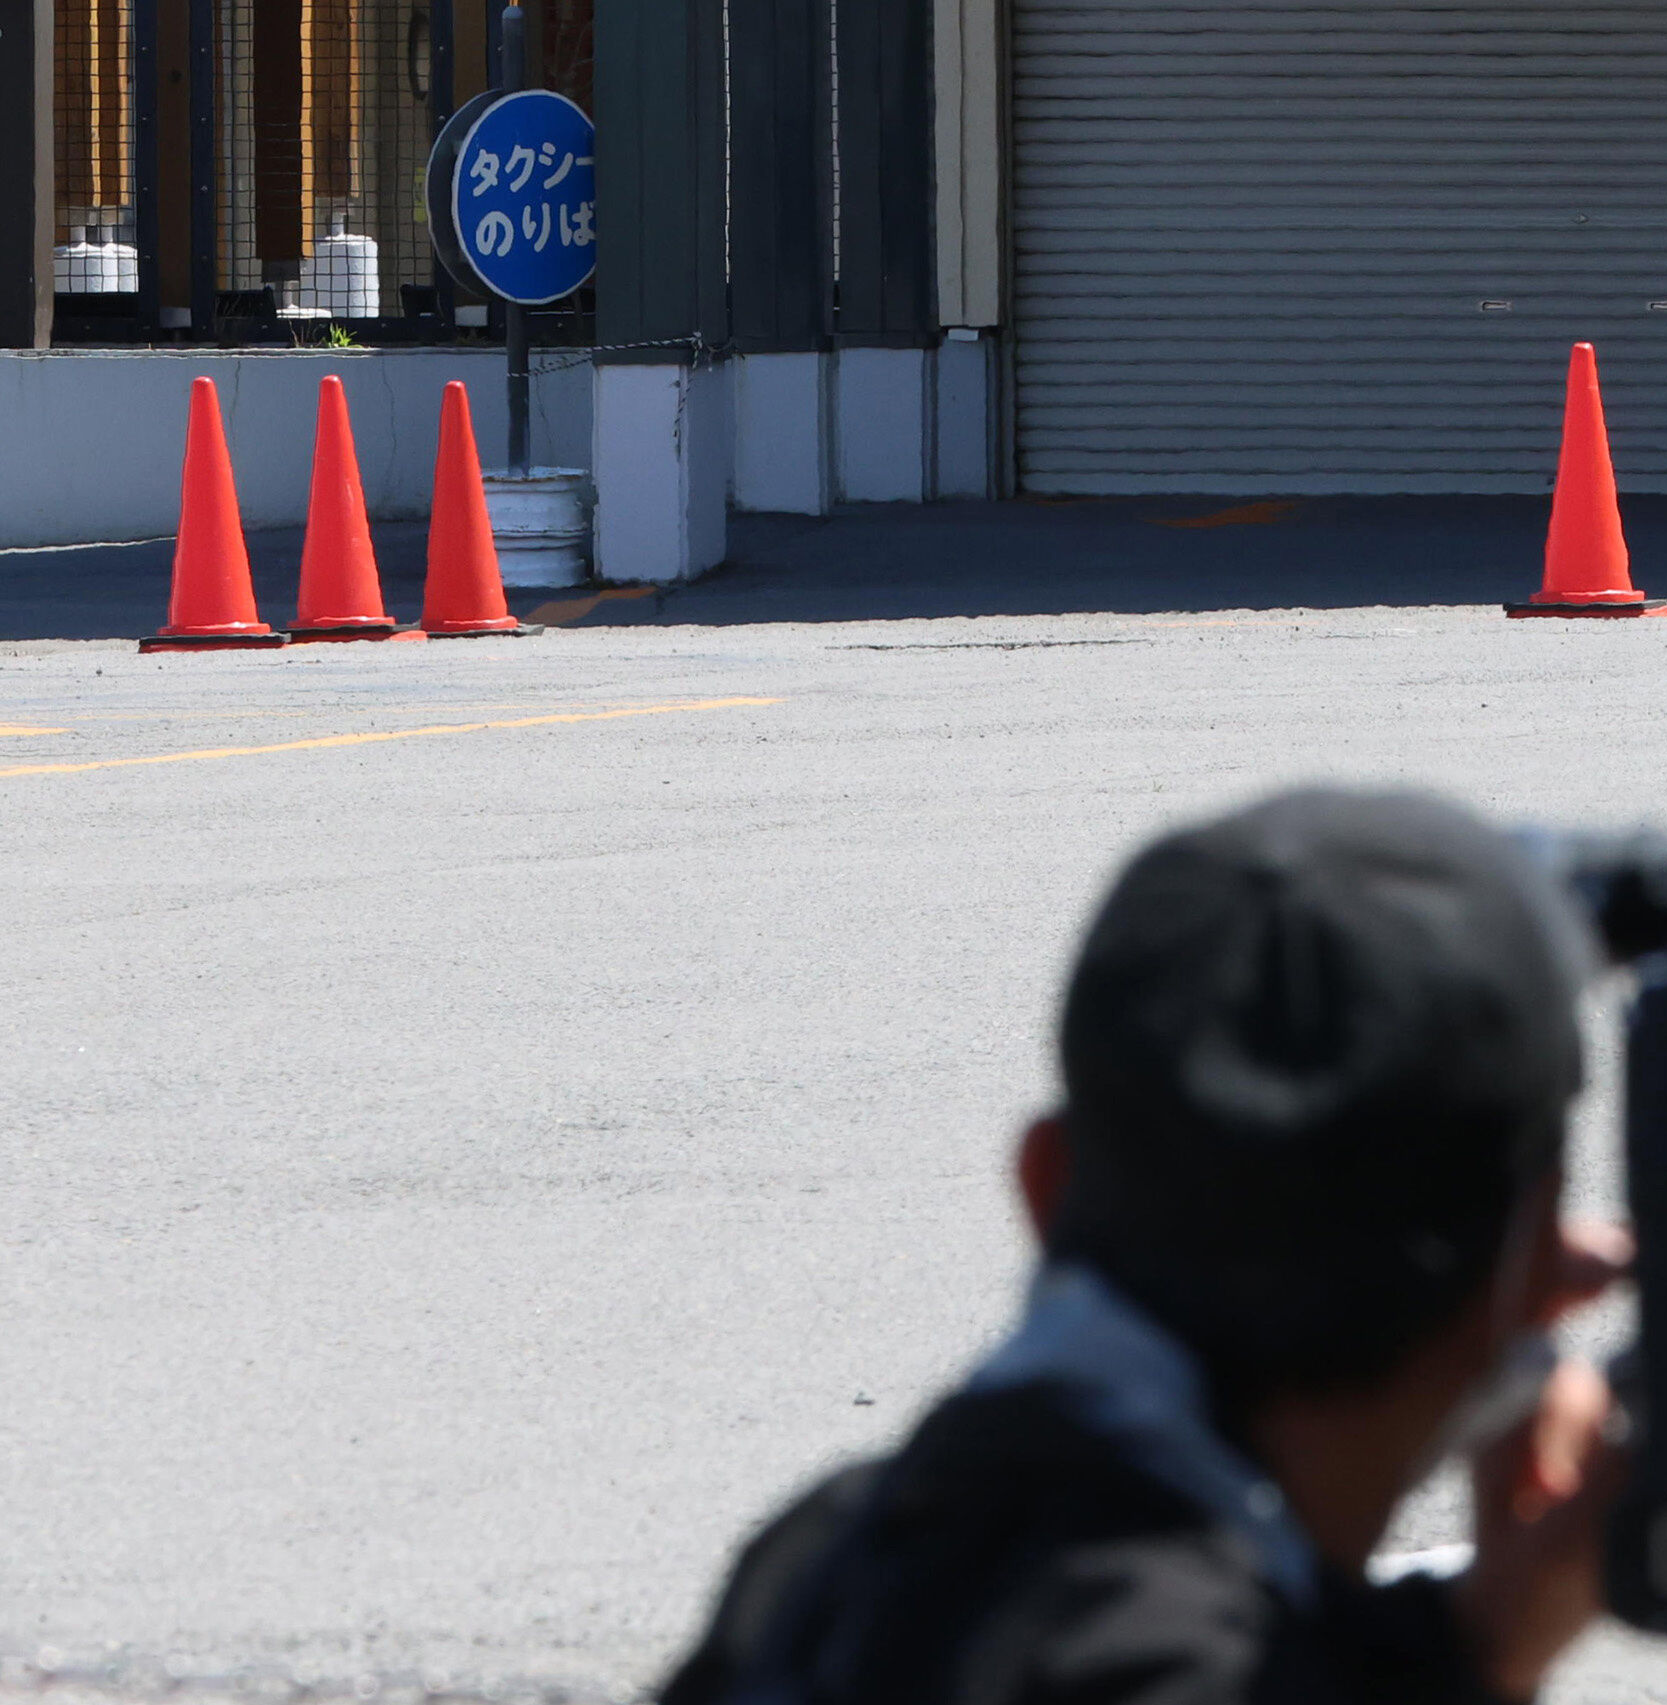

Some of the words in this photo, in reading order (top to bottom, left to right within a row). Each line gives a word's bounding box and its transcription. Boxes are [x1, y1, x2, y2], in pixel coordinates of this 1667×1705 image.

[470, 142, 595, 197] タクシー
[476, 201, 597, 257] のりば
